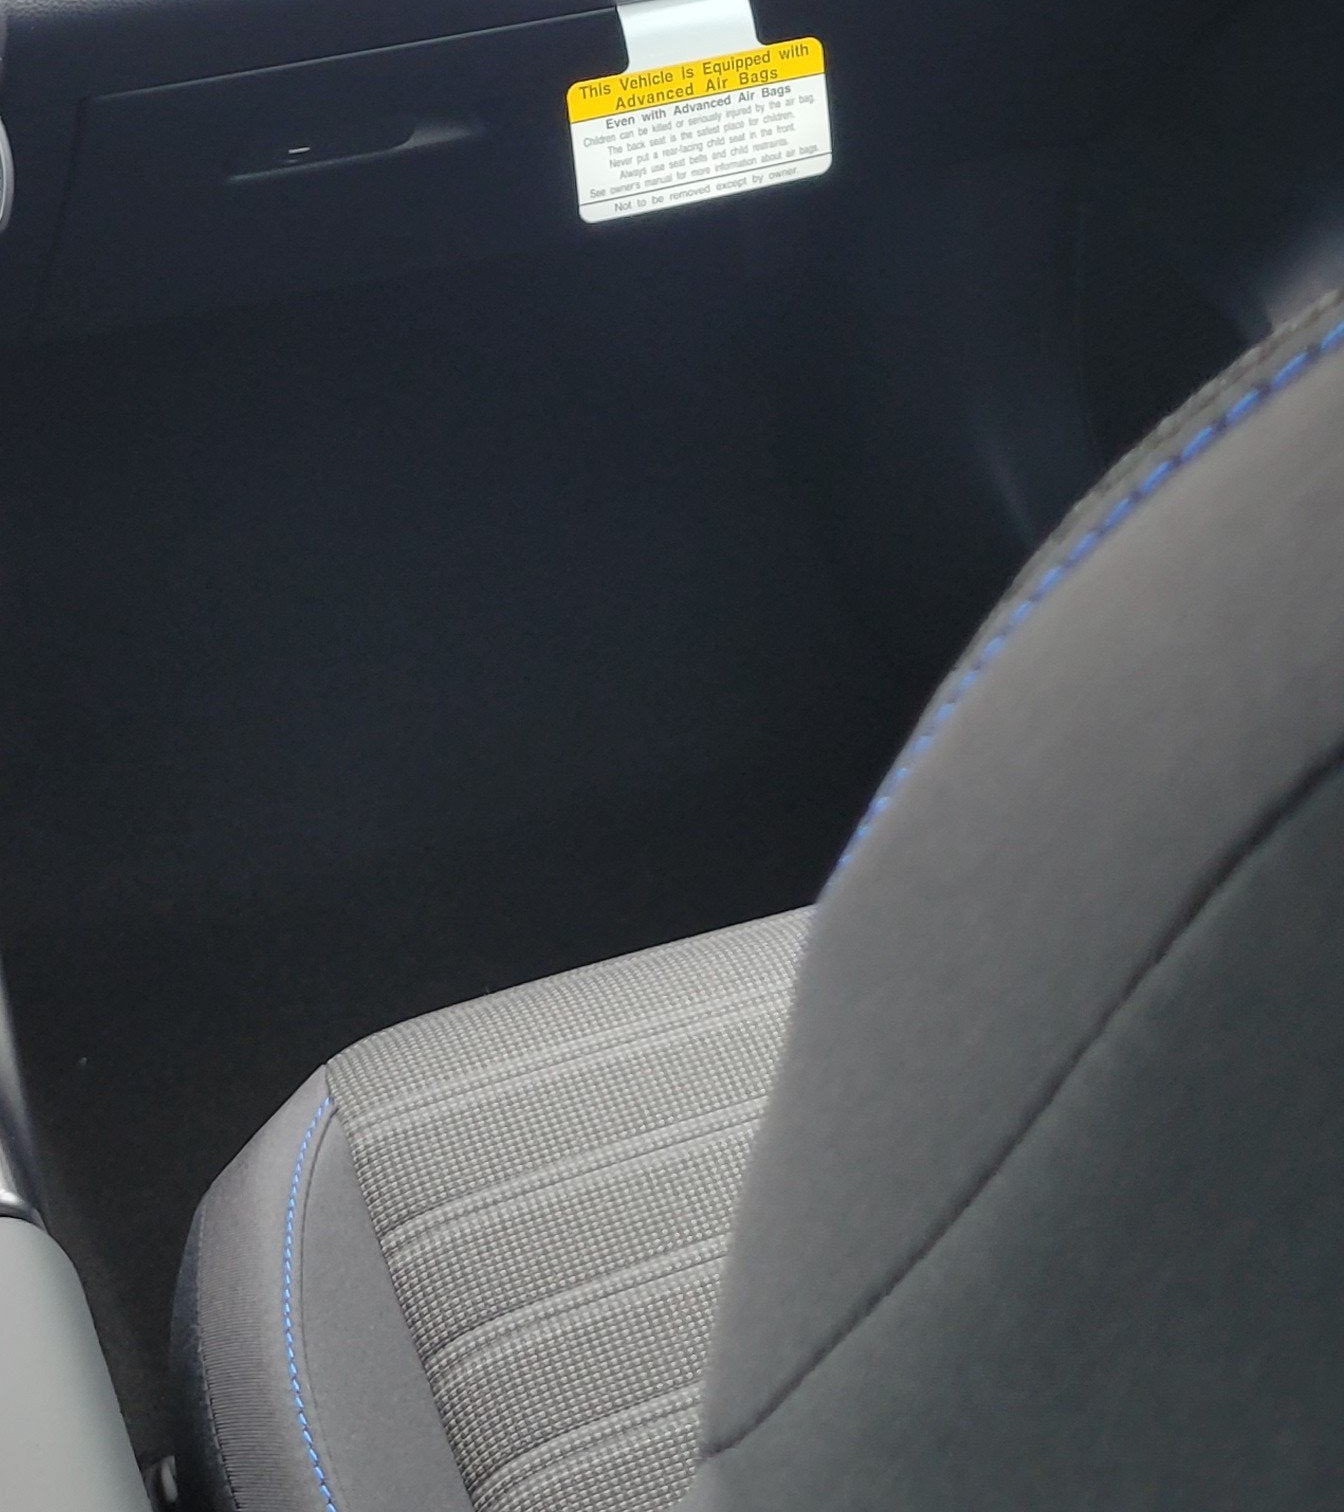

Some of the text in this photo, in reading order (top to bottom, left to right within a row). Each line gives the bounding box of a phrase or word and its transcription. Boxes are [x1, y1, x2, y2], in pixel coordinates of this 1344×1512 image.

[580, 43, 809, 100] This Vehicle is Equipped with
[616, 68, 778, 110] Advanced Air Bags
[606, 84, 791, 129] Even with Advanced Air Bags
[583, 134, 616, 147] Children
[637, 128, 648, 136] be
[608, 145, 623, 156] The
[609, 157, 633, 169] Never
[590, 188, 606, 198] See
[614, 202, 632, 212] Not
[637, 198, 647, 207] to
[651, 195, 664, 204] be
[669, 185, 711, 200] removed
[752, 175, 764, 184] by
